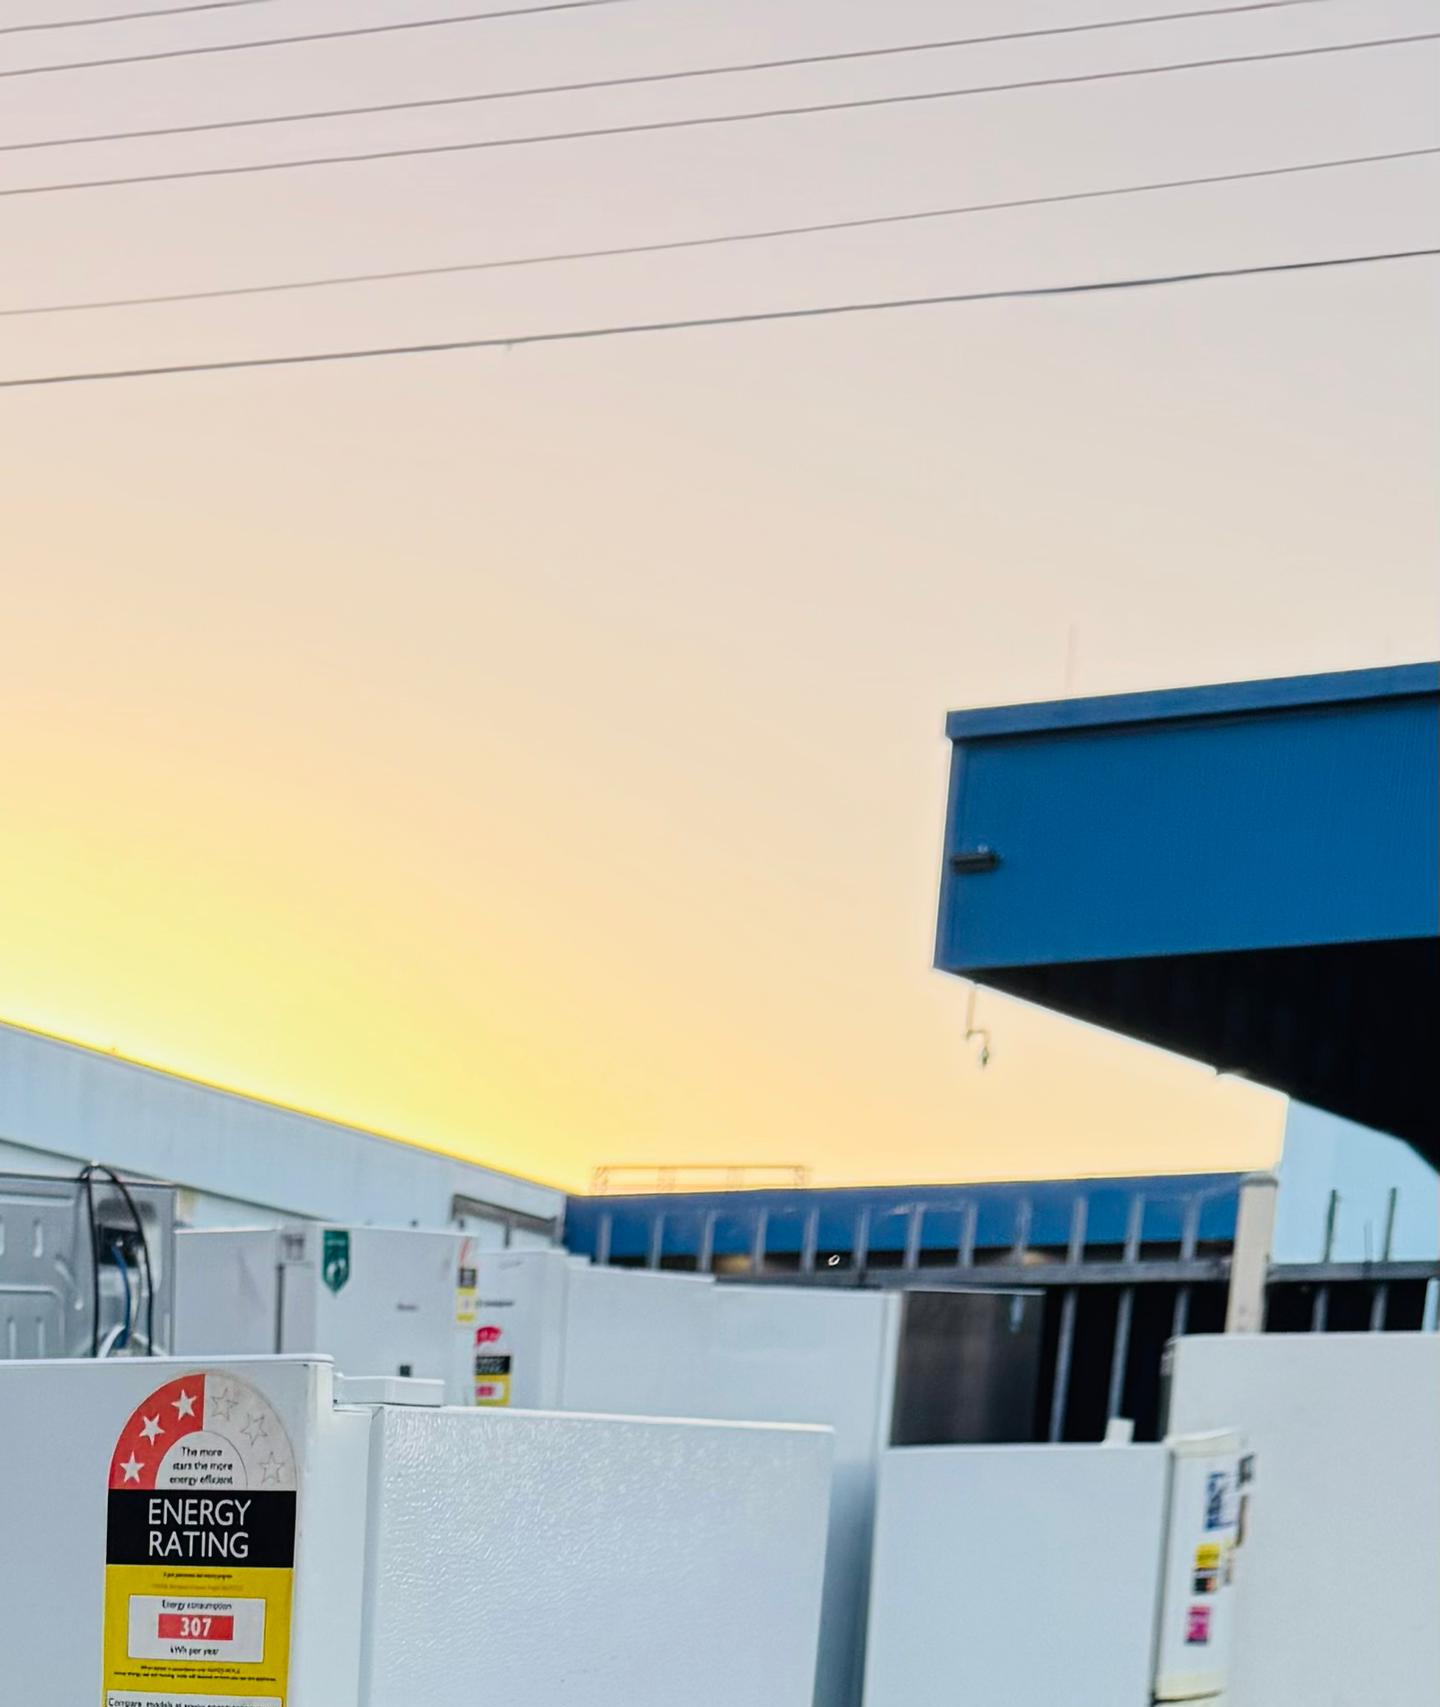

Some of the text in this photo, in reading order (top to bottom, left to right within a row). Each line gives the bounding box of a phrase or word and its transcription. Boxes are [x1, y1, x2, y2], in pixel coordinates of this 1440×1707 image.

[182, 1446, 223, 1457] The more
[148, 1498, 252, 1526] ENERGY
[148, 1530, 249, 1558] RATING
[180, 1616, 212, 1637] 307
